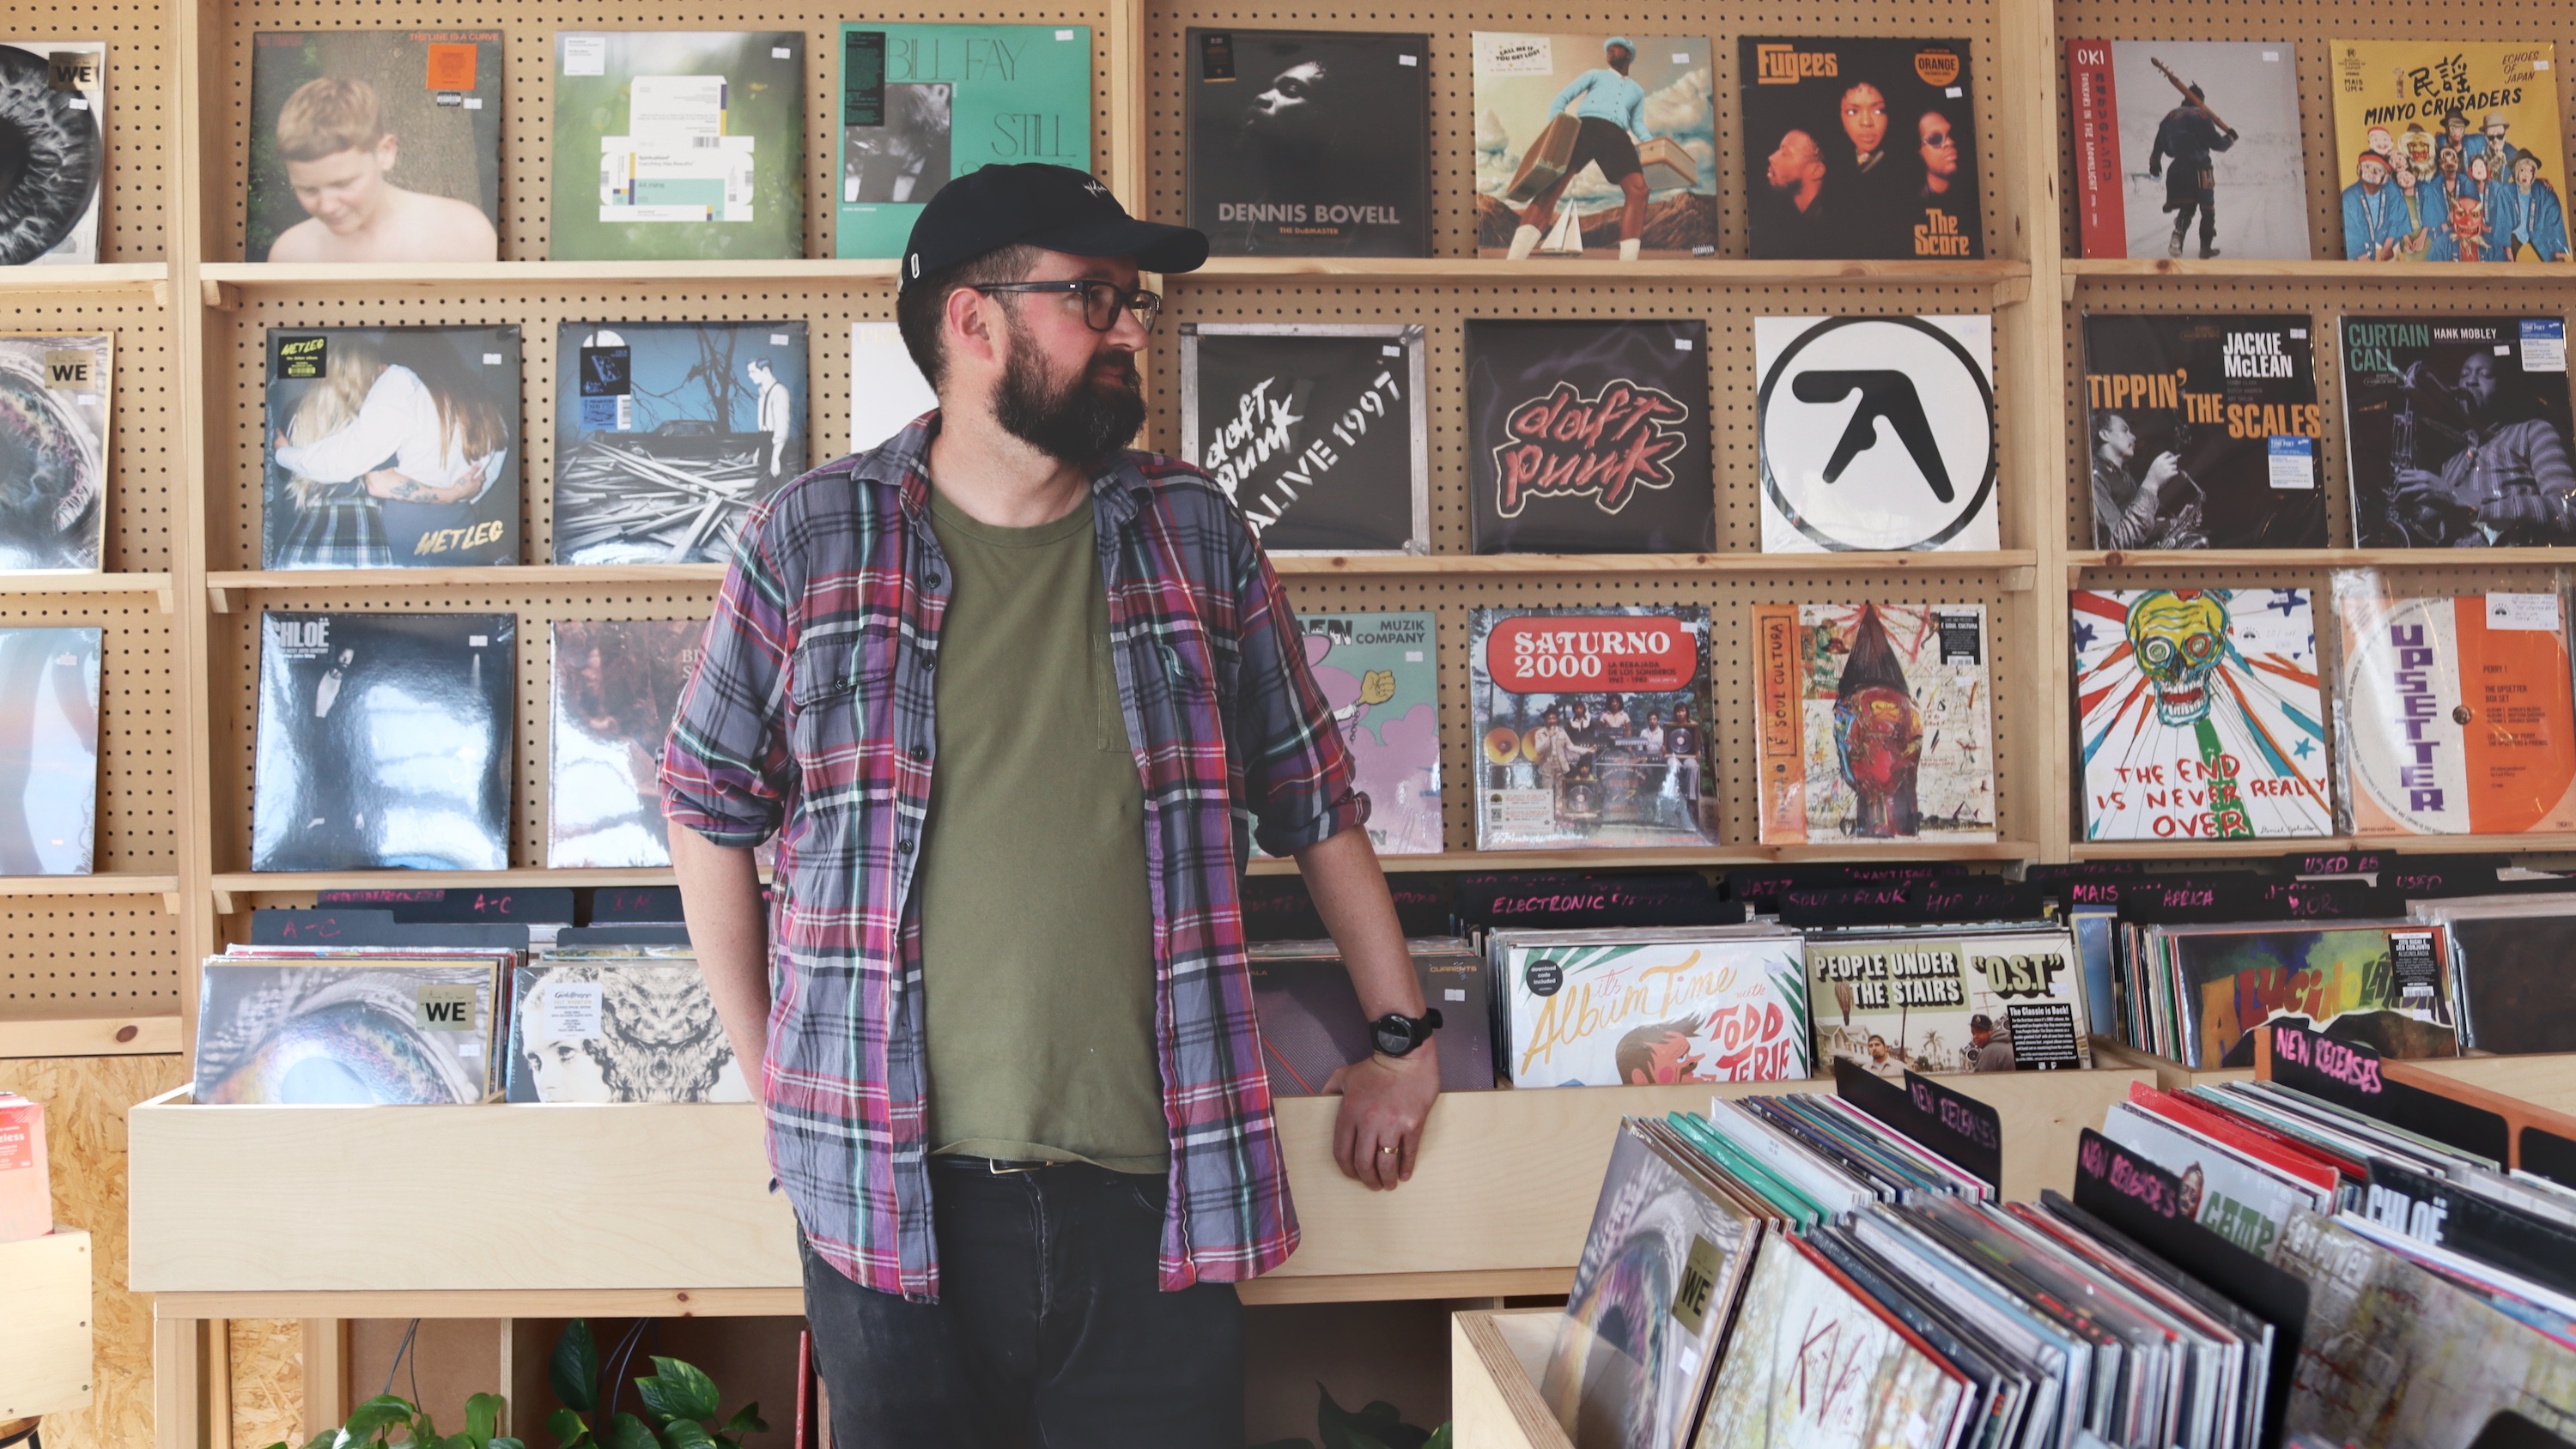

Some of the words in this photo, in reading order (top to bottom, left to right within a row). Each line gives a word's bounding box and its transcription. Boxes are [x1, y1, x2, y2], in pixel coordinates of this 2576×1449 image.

[429, 33, 448, 41] LINE
[450, 33, 459, 41] IS
[461, 33, 468, 41] A
[469, 33, 499, 41] CURVE
[965, 38, 1027, 82] FAY
[1757, 44, 1838, 84] Fugees
[1917, 57, 1956, 71] ORANGE
[2077, 49, 2105, 66] OKI
[2502, 51, 2540, 66] ECHOES
[2503, 64, 2518, 75] OF
[2505, 70, 2536, 85] JAPAN
[2364, 102, 2416, 126] MINYO
[2421, 88, 2523, 117] CRUSADERS
[992, 112, 1077, 157] STILL
[1218, 203, 1307, 223] DENNIS
[1315, 204, 1400, 224] BOVELL
[1926, 208, 1958, 235] The
[1914, 224, 1970, 256] Score
[2222, 331, 2282, 356] JACKIE
[2348, 324, 2430, 348] CURTAIN
[2433, 328, 2458, 340] HANK
[2460, 328, 2497, 340] MOBLEY
[2223, 355, 2293, 379] McLEAN
[2350, 348, 2397, 373] CALL
[2184, 393, 2225, 423] THE
[2227, 403, 2322, 440] SCALES
[1245, 438, 1340, 539] ALIVE
[1332, 370, 1401, 446] 1997
[1504, 424, 1674, 507] punk
[1380, 620, 1425, 631] MUZIK
[1356, 633, 1425, 645] COMPANY
[1515, 631, 1671, 655] SATURNO
[1771, 622, 1787, 686] CULTURA
[1515, 655, 1602, 678] 2000
[2483, 665, 2502, 674] PERRY
[1774, 691, 1788, 727] SOUL
[2486, 694, 2497, 703] BOX
[2499, 694, 2509, 703] SET
[2391, 624, 2445, 812] UPSETTER
[2114, 764, 2164, 785] THE
[2177, 754, 2240, 783] END
[2097, 791, 2126, 810] IS
[2147, 785, 2241, 809] NEVER
[2251, 778, 2326, 797] REALLY
[2153, 810, 2247, 838] OVER
[2305, 857, 2348, 873] USED
[1741, 878, 1793, 898] JAZZ
[2072, 884, 2119, 903] MAIS
[2397, 876, 2442, 891] USED
[1492, 893, 1606, 915] ELECTRONIC
[1853, 888, 1908, 905] FUNK
[1430, 965, 1478, 973] CURRENTS
[1814, 954, 1887, 980] PEOPLE
[1890, 950, 1959, 977] UNDER
[1735, 984, 1767, 999] with
[1850, 981, 1887, 1008] THE
[1892, 978, 1963, 1004] STAIRS
[1521, 983, 1649, 1076] Album
[1638, 949, 1739, 1020] Time
[2009, 1006, 2021, 1016] The
[2021, 1006, 2044, 1016] Classic
[2275, 1026, 2311, 1068] NEW
[2313, 1038, 2382, 1094] RELEASES
[0, 1132, 26, 1143] eless
